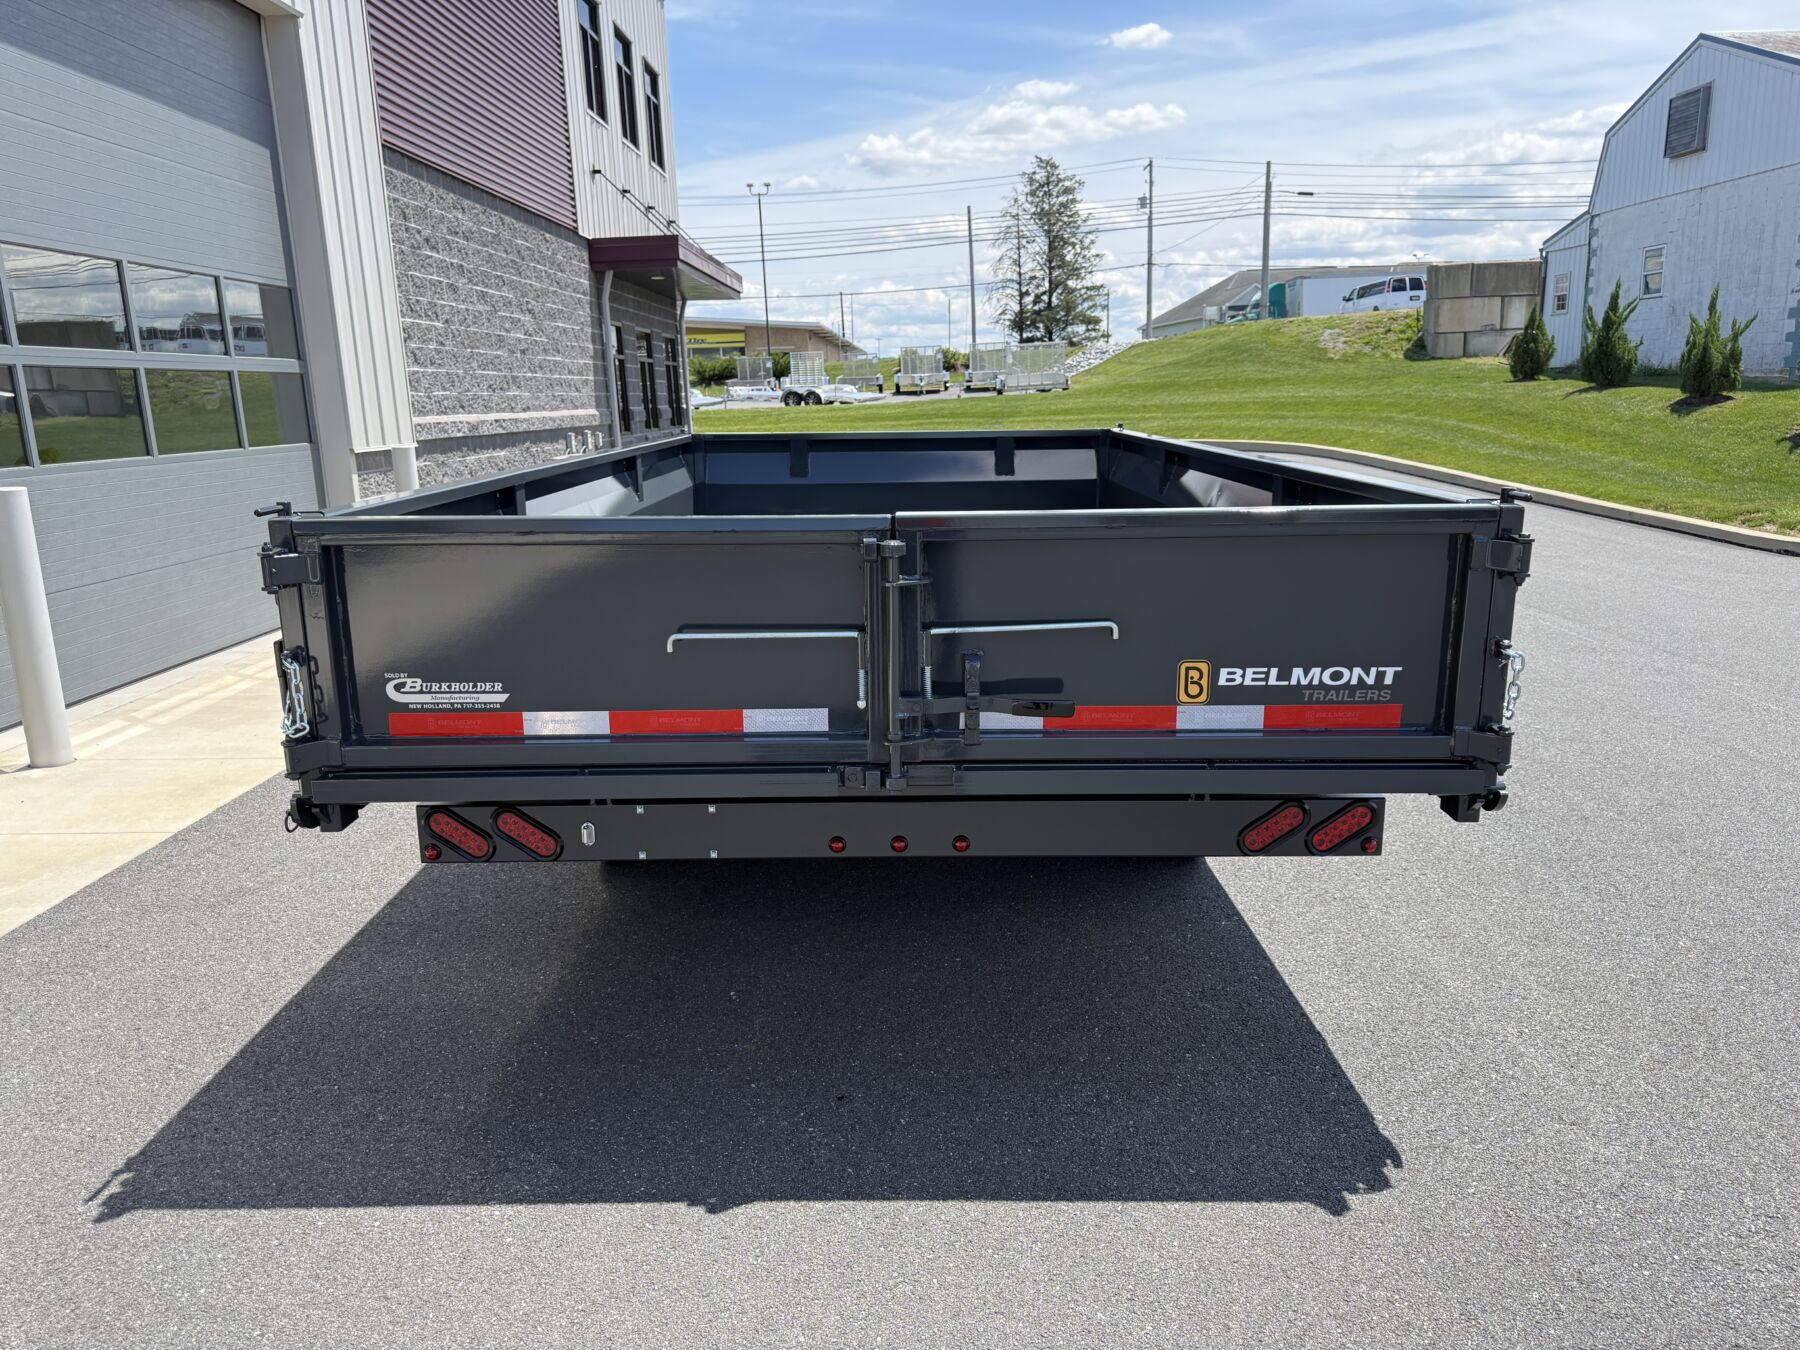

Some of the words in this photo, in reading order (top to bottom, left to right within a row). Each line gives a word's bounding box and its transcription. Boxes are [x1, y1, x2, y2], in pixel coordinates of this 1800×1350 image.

[1217, 666, 1402, 685] BELMONT
[400, 678, 503, 692] BURKHOLDER
[1302, 690, 1392, 701] TRAILERS
